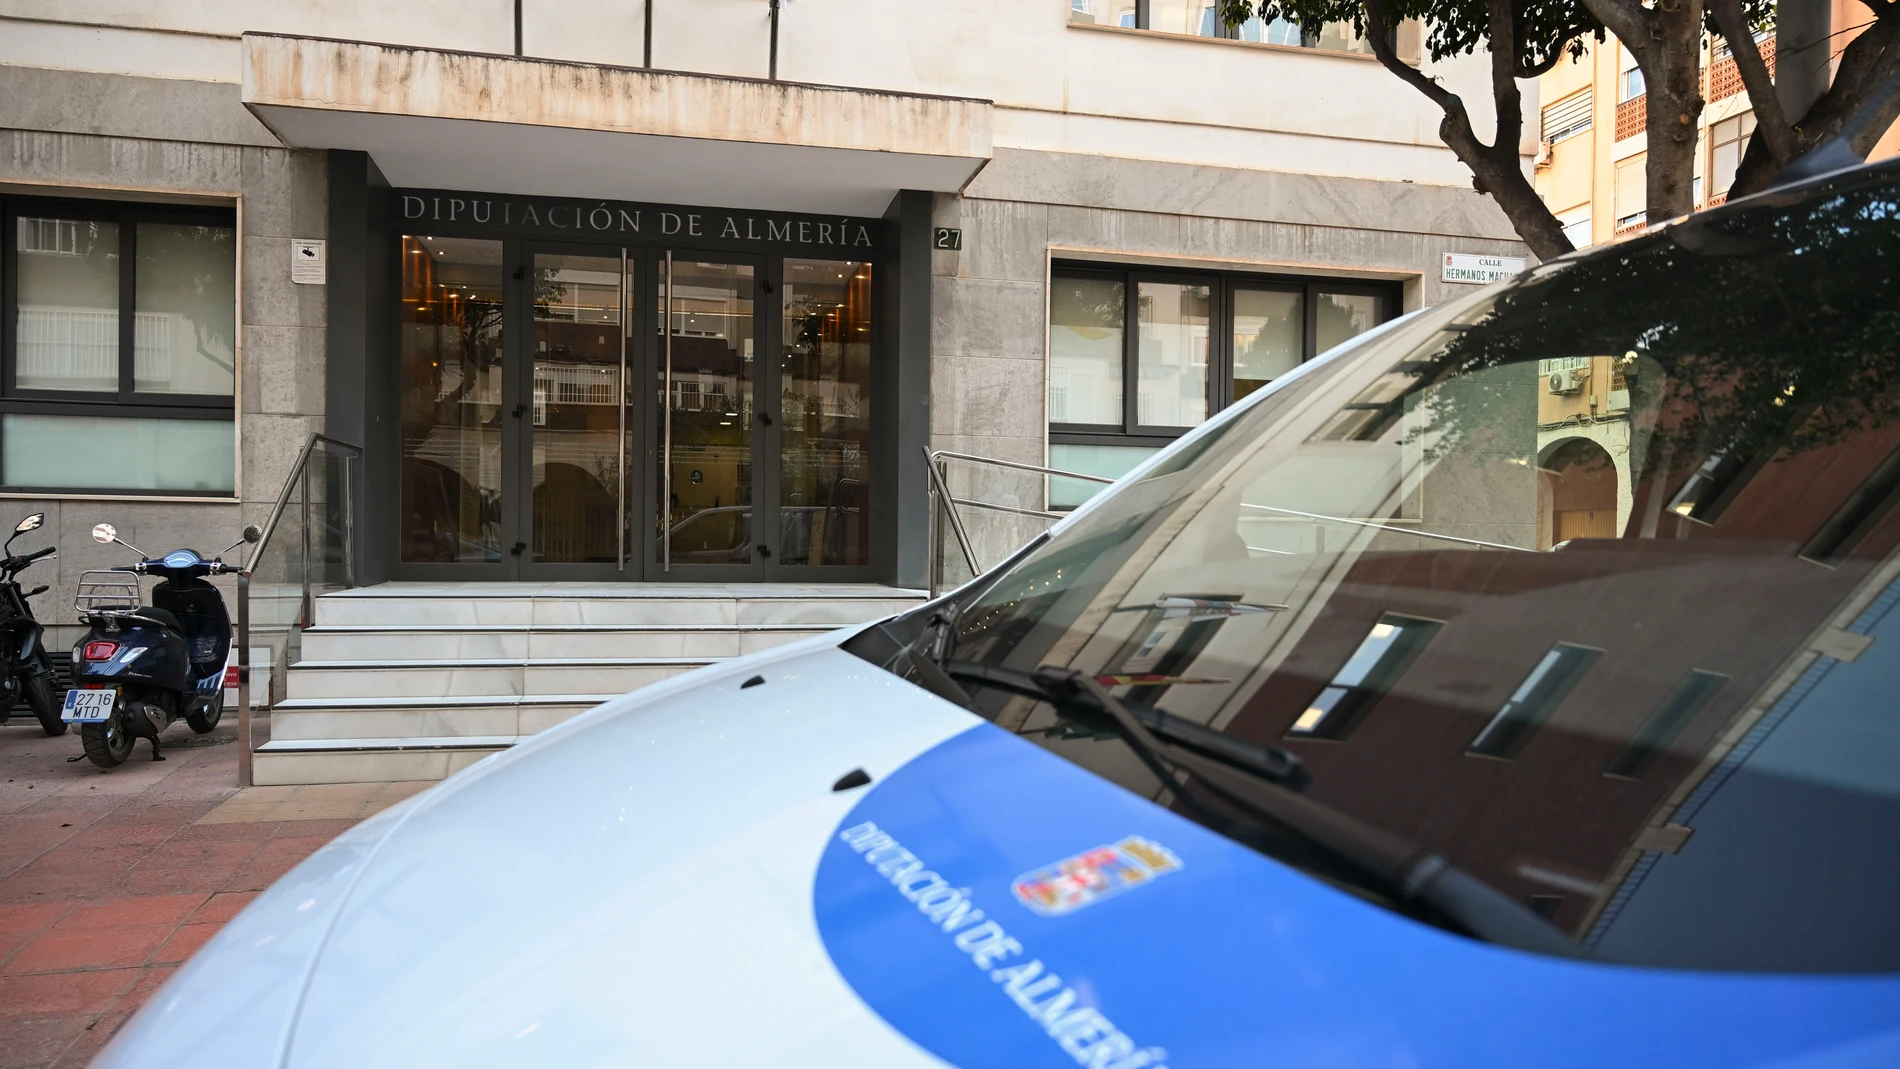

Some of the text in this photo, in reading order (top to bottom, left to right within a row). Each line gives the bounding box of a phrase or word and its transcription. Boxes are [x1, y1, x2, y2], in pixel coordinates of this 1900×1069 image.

[402, 195, 873, 247] DIPUTACIÓN DE ALMERÍA
[938, 228, 961, 248] 27
[1479, 258, 1503, 267] CALLE
[1445, 268, 1486, 281] HERMANOS
[72, 706, 100, 719] MTD
[840, 820, 1169, 1069] DIPUTACIÓN DE ALMERÍ
